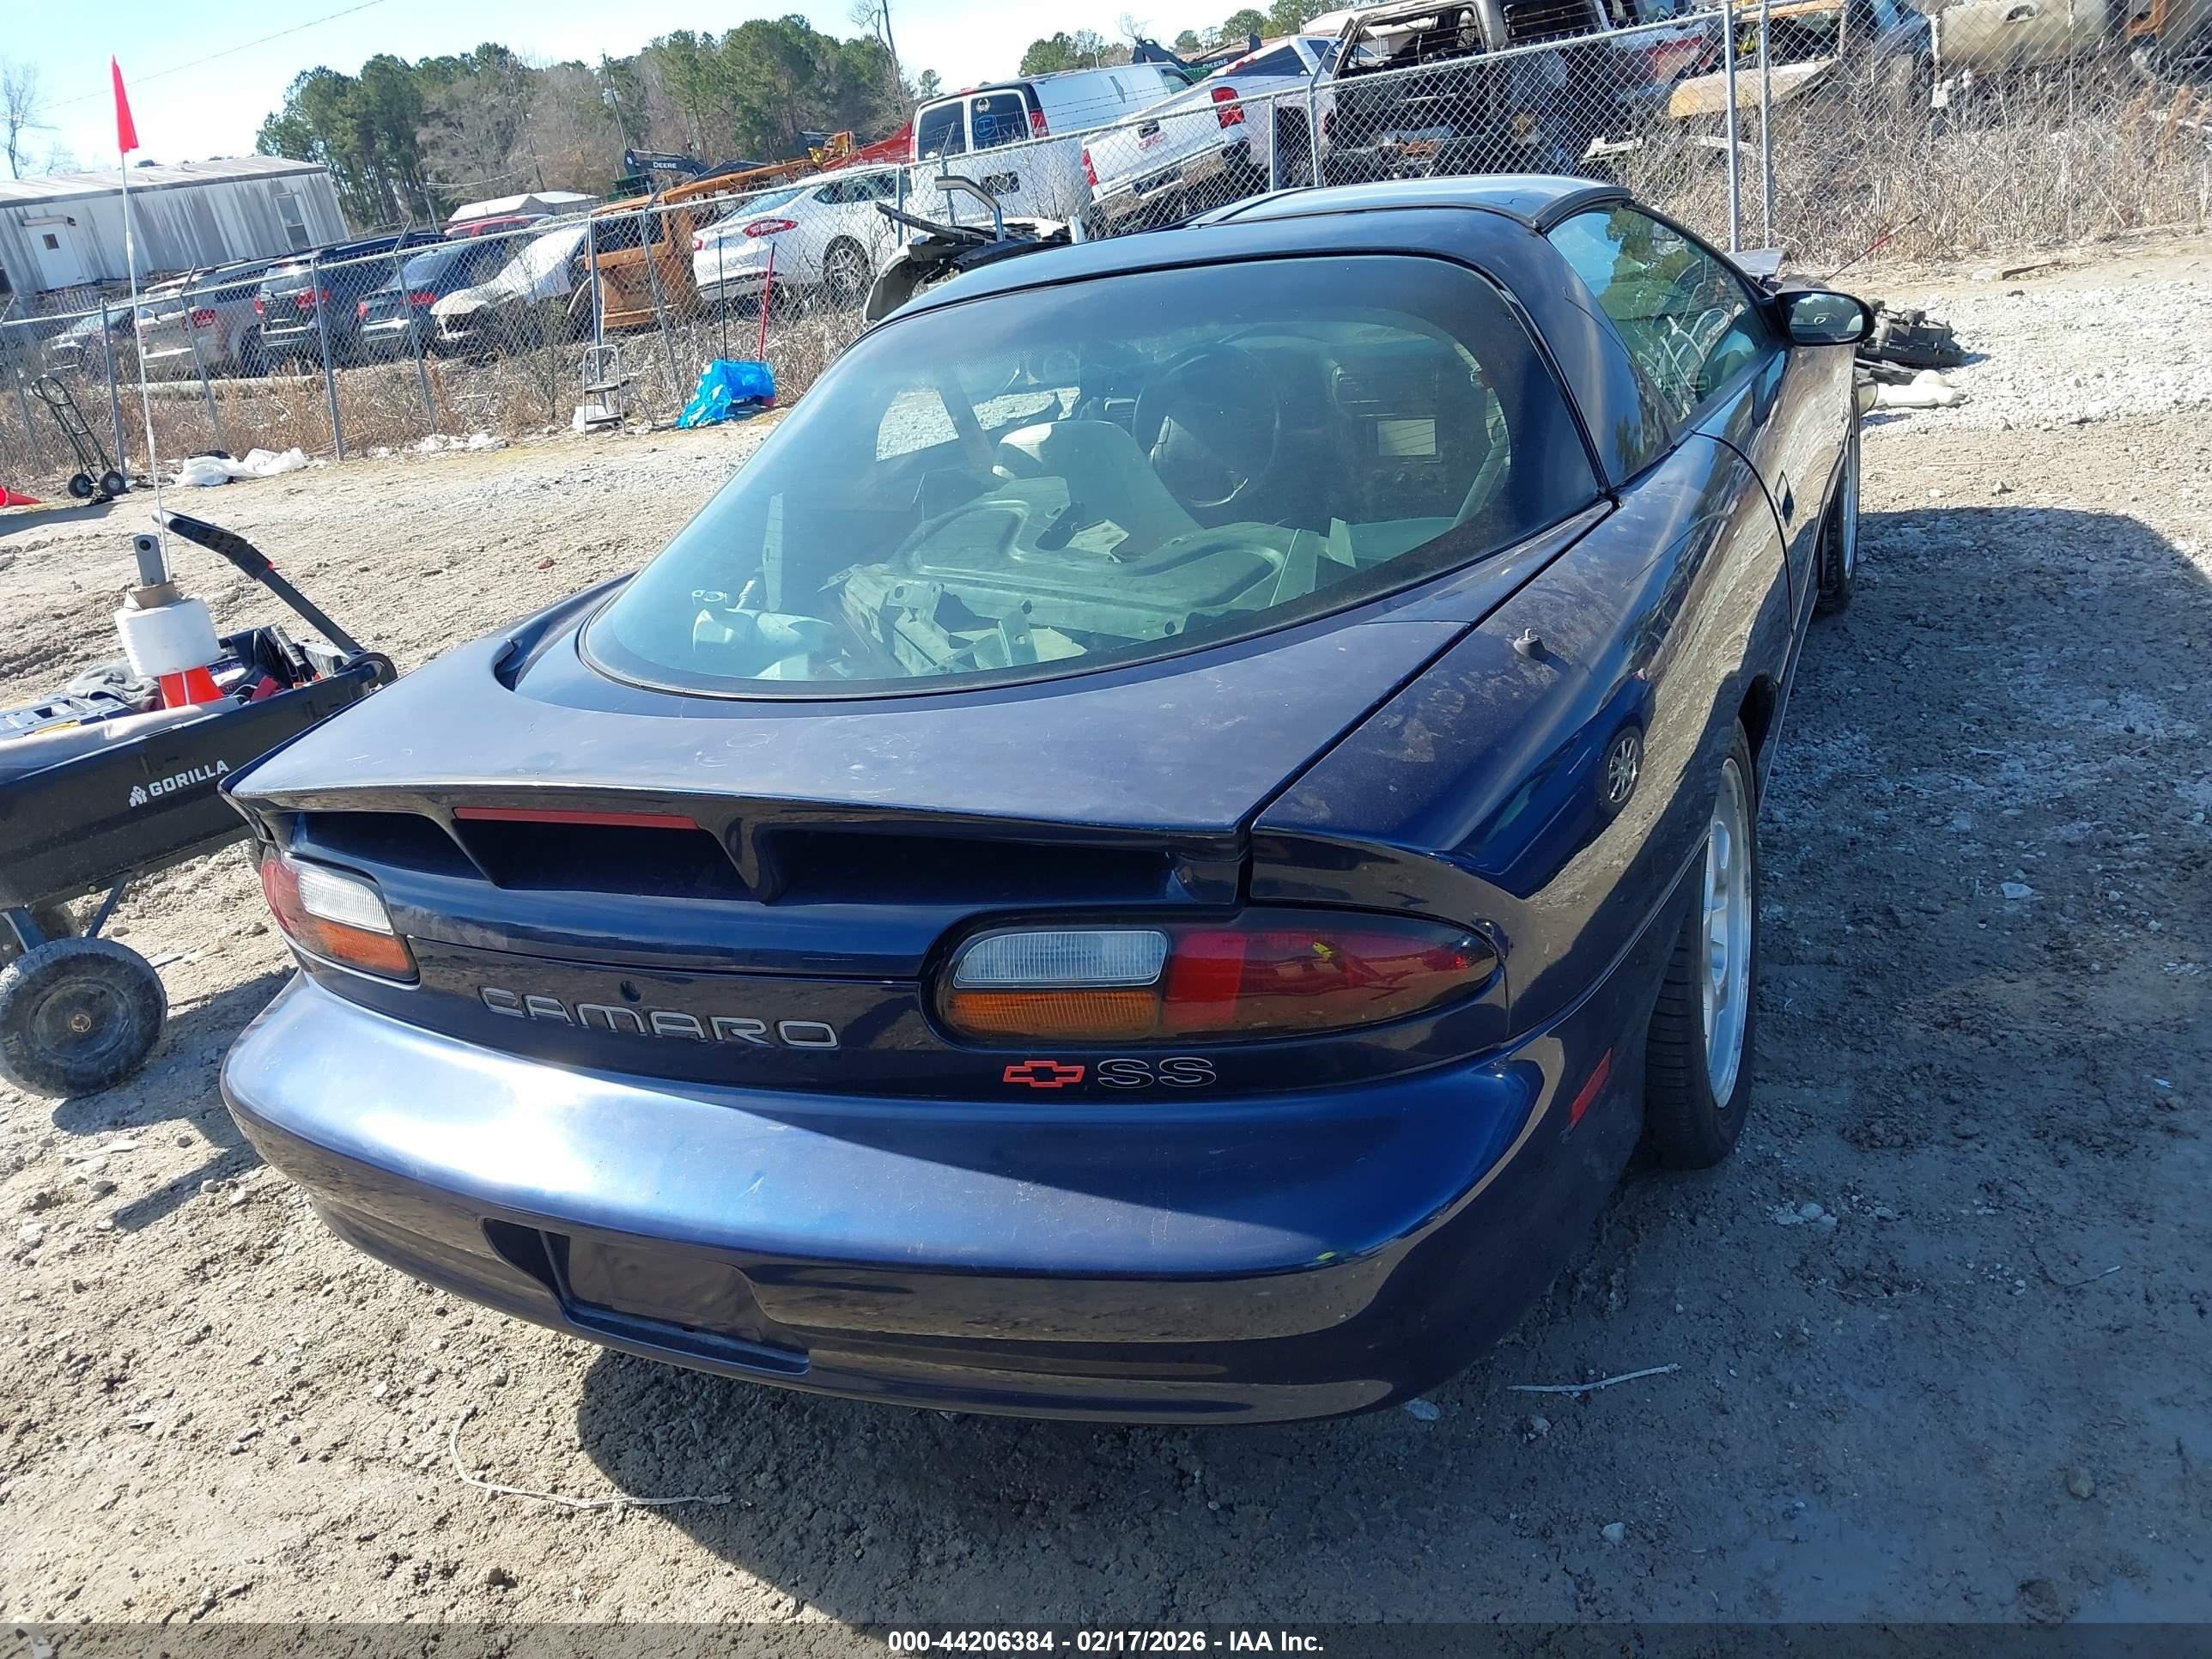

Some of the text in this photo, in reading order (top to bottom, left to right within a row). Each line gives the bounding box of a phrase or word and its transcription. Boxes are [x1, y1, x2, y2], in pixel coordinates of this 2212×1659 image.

[1202, 58, 1229, 69] DEERE
[149, 760, 229, 797] GORILLA
[478, 986, 840, 1050] CAMARO
[1097, 1057, 1216, 1088] SS
